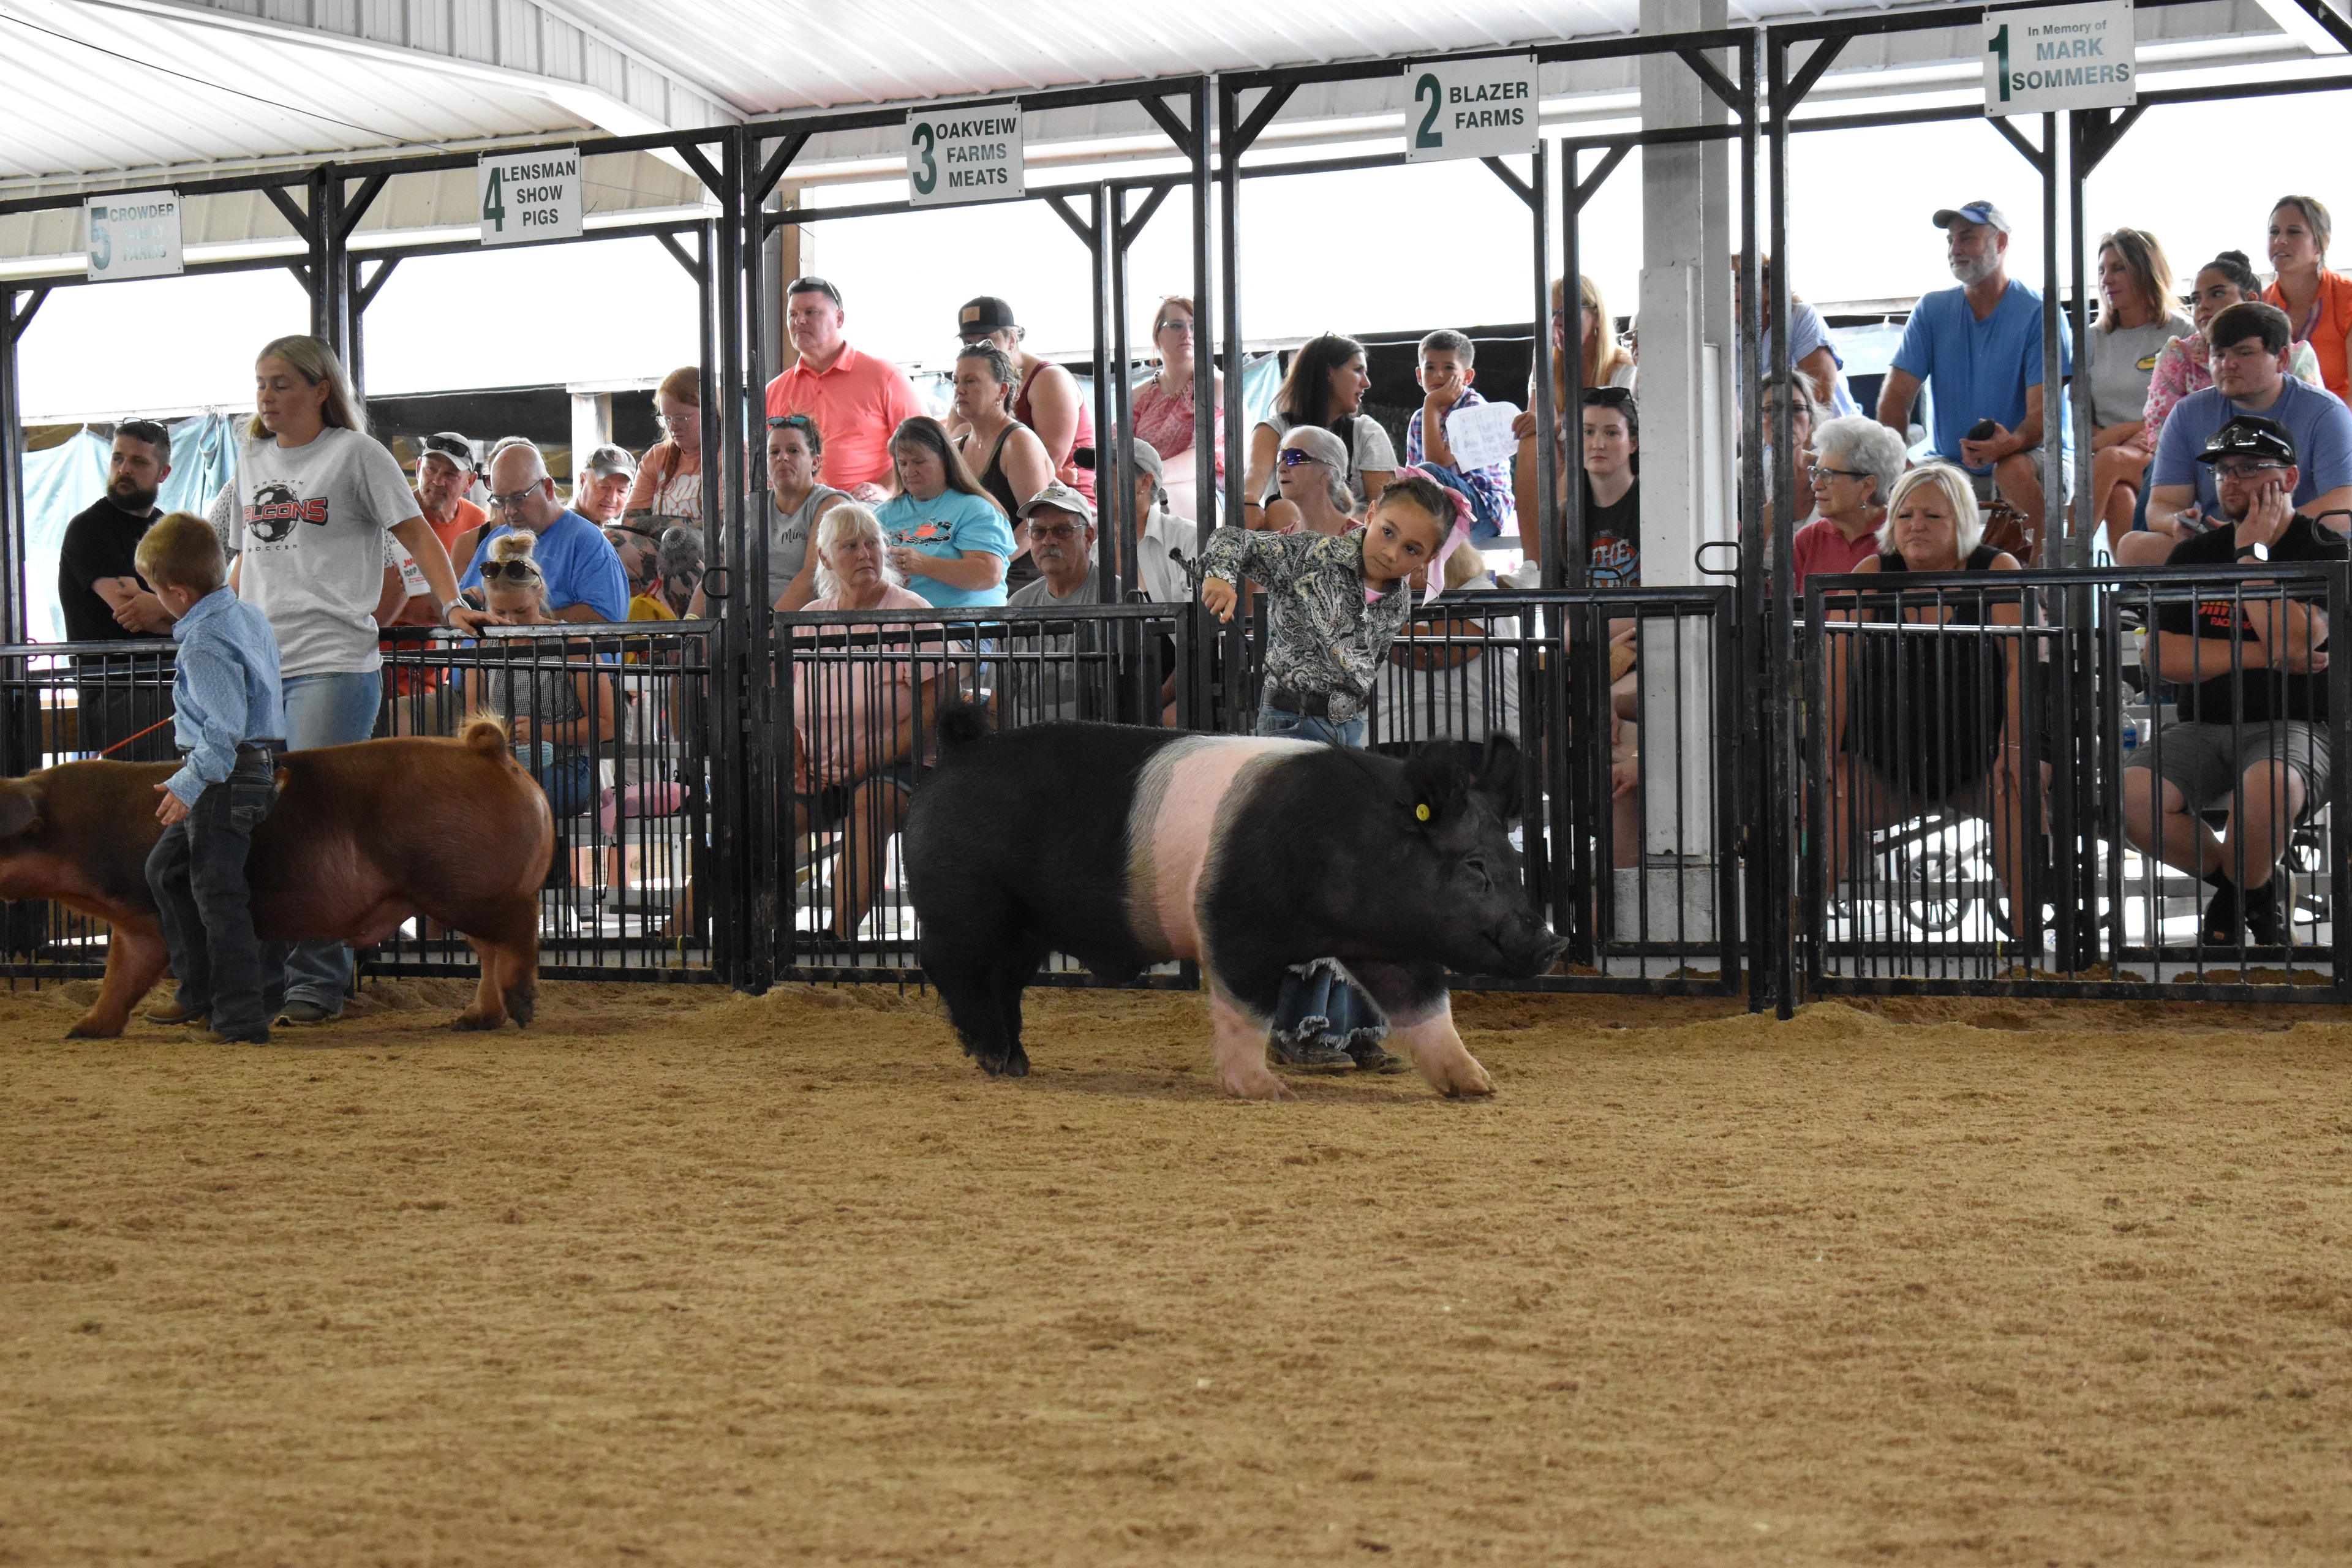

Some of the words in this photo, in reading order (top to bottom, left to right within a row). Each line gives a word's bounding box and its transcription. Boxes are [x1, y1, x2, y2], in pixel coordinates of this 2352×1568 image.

[2028, 27, 2038, 36] In
[2043, 23, 2091, 36] Memory
[2095, 20, 2107, 30] of
[2037, 37, 2103, 61] MARK
[1988, 24, 2010, 102] 1
[2012, 63, 2130, 91] SOMMERS
[1450, 81, 1528, 104] BLAZER
[1415, 73, 1442, 149] 2
[1455, 108, 1524, 129] FARMS
[936, 118, 1017, 140] OAKVEIW
[912, 123, 937, 195] 3
[947, 143, 1007, 163] FARMS
[502, 160, 576, 182] LENSMAN
[949, 167, 1008, 187] MEATS
[483, 167, 505, 232] 4
[516, 185, 563, 204] SHOW
[110, 203, 175, 222] CROWDER
[522, 208, 559, 226] PIGS
[91, 206, 111, 270] 5
[243, 497, 328, 529] ALCONS
